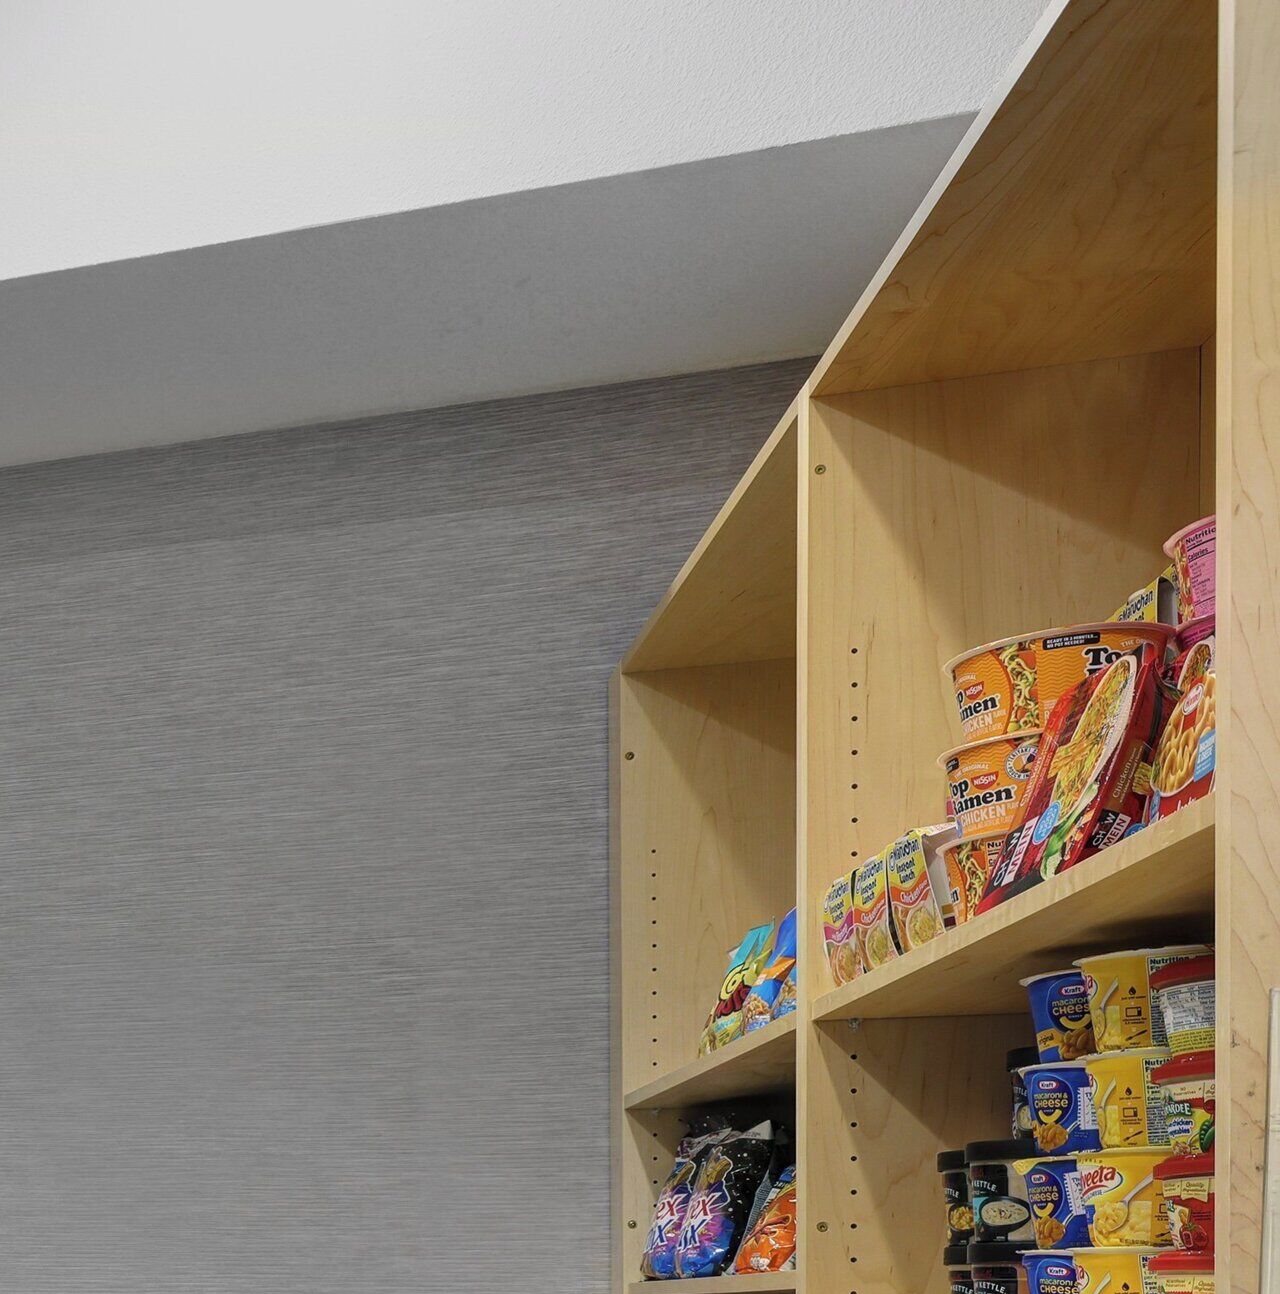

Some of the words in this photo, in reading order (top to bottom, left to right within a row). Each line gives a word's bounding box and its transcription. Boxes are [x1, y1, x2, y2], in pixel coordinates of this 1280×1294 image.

[1188, 547, 1208, 560] Calories
[1118, 590, 1153, 622] Maruchan
[965, 684, 984, 697] NISSIN
[963, 762, 990, 773] ORIGINAL
[972, 774, 997, 786] NISSIN
[1112, 761, 1131, 798] Chicken
[961, 806, 1007, 826] CHICKEN
[1103, 817, 1126, 848] MEIN
[890, 838, 920, 868] Maruchan
[1008, 823, 1034, 876] MEIN
[896, 858, 915, 874] Instant
[900, 871, 915, 883] Lunch
[860, 879, 877, 896] Instant
[862, 892, 875, 905] Lunch
[901, 888, 920, 903] Chicken
[1149, 956, 1190, 965] Nutrition
[1064, 986, 1082, 994] Kraft
[1034, 1092, 1062, 1100] macaroni
[1029, 1186, 1052, 1194] macaroni
[1040, 1278, 1072, 1286] macaroni
